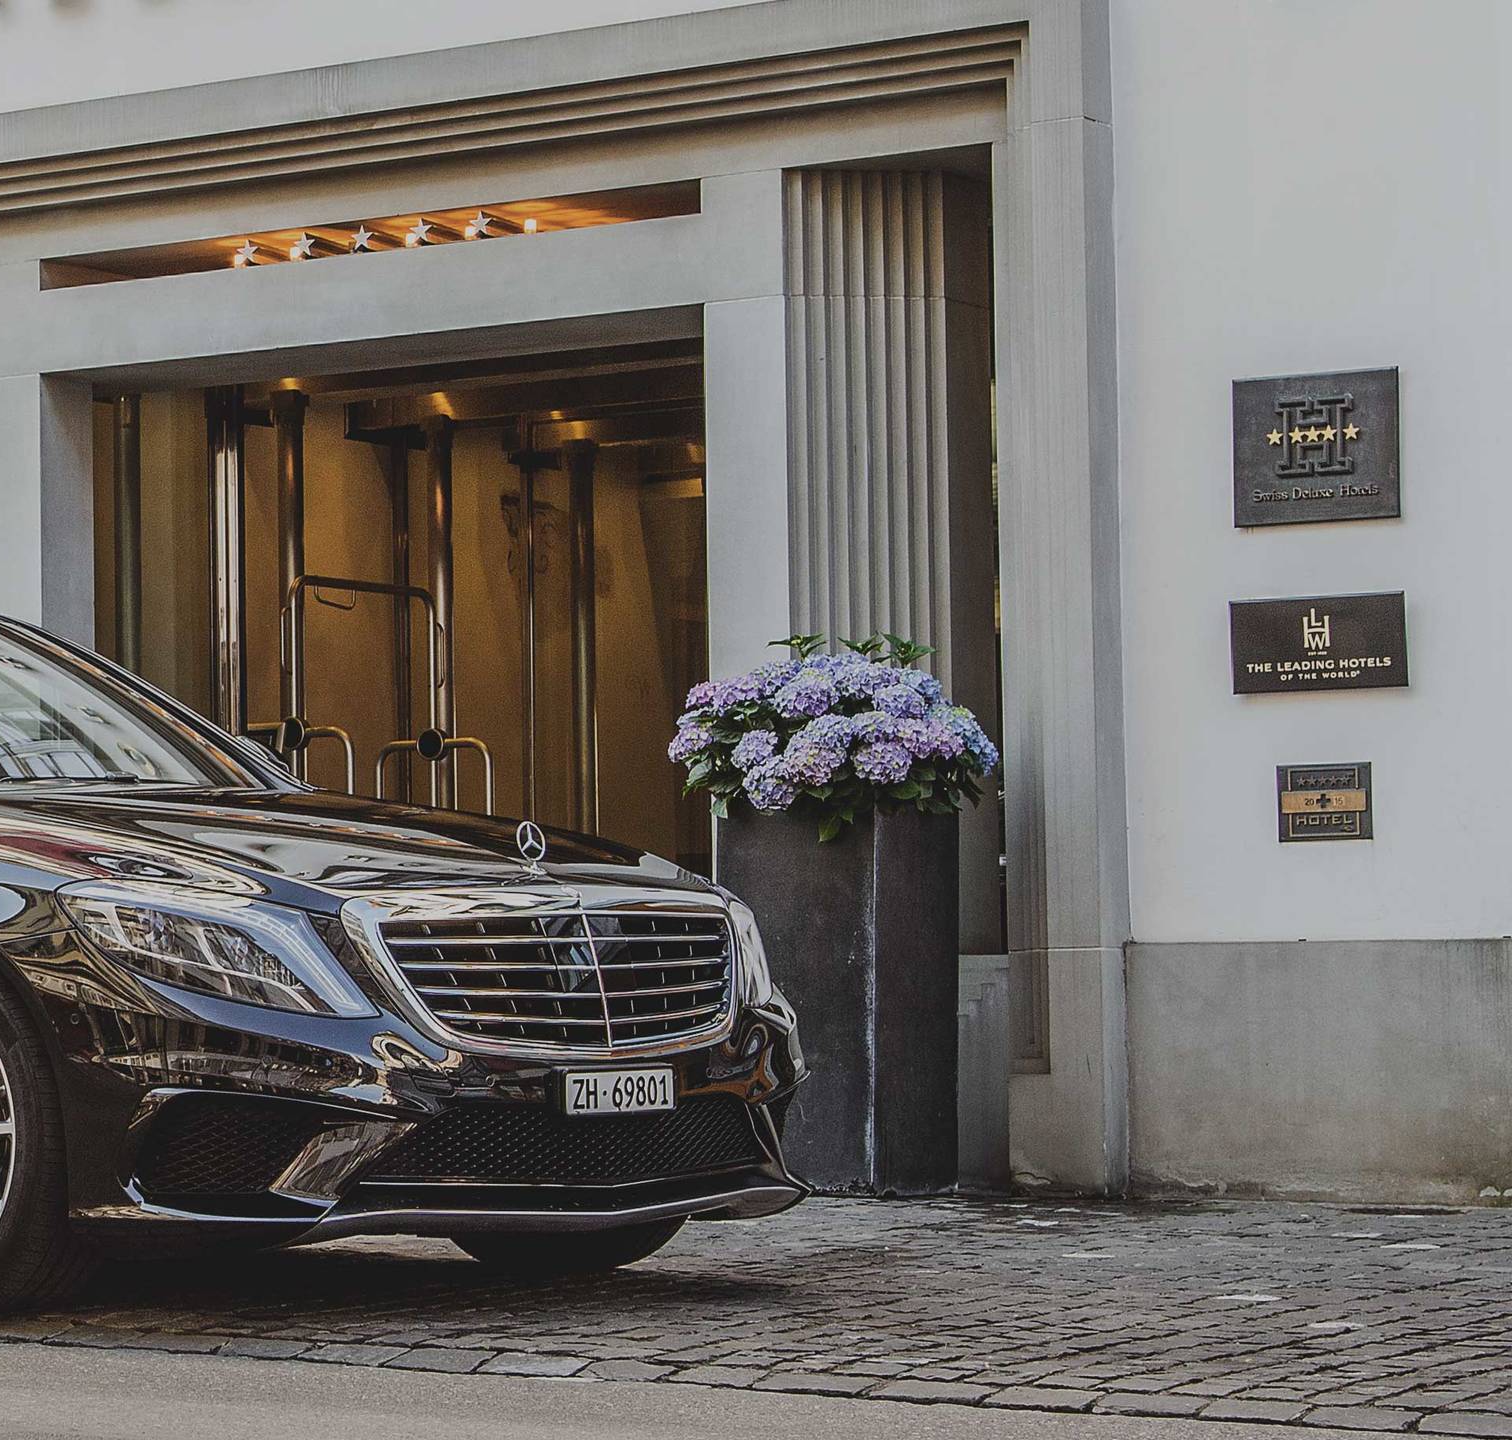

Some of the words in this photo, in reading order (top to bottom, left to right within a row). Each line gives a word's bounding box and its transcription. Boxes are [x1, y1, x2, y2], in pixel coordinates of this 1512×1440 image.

[1252, 488, 1289, 502] Swiss
[1292, 486, 1334, 501] Deluxe
[1339, 482, 1379, 496] Hotels
[1246, 662, 1273, 673] THE
[1277, 659, 1335, 672] LEADING
[1339, 656, 1392, 668] HOTELS
[1280, 673, 1294, 681] OF
[1298, 672, 1317, 680] THE
[1304, 798, 1315, 806] 20
[1335, 797, 1343, 805] 15
[1296, 814, 1353, 825] HOTEL
